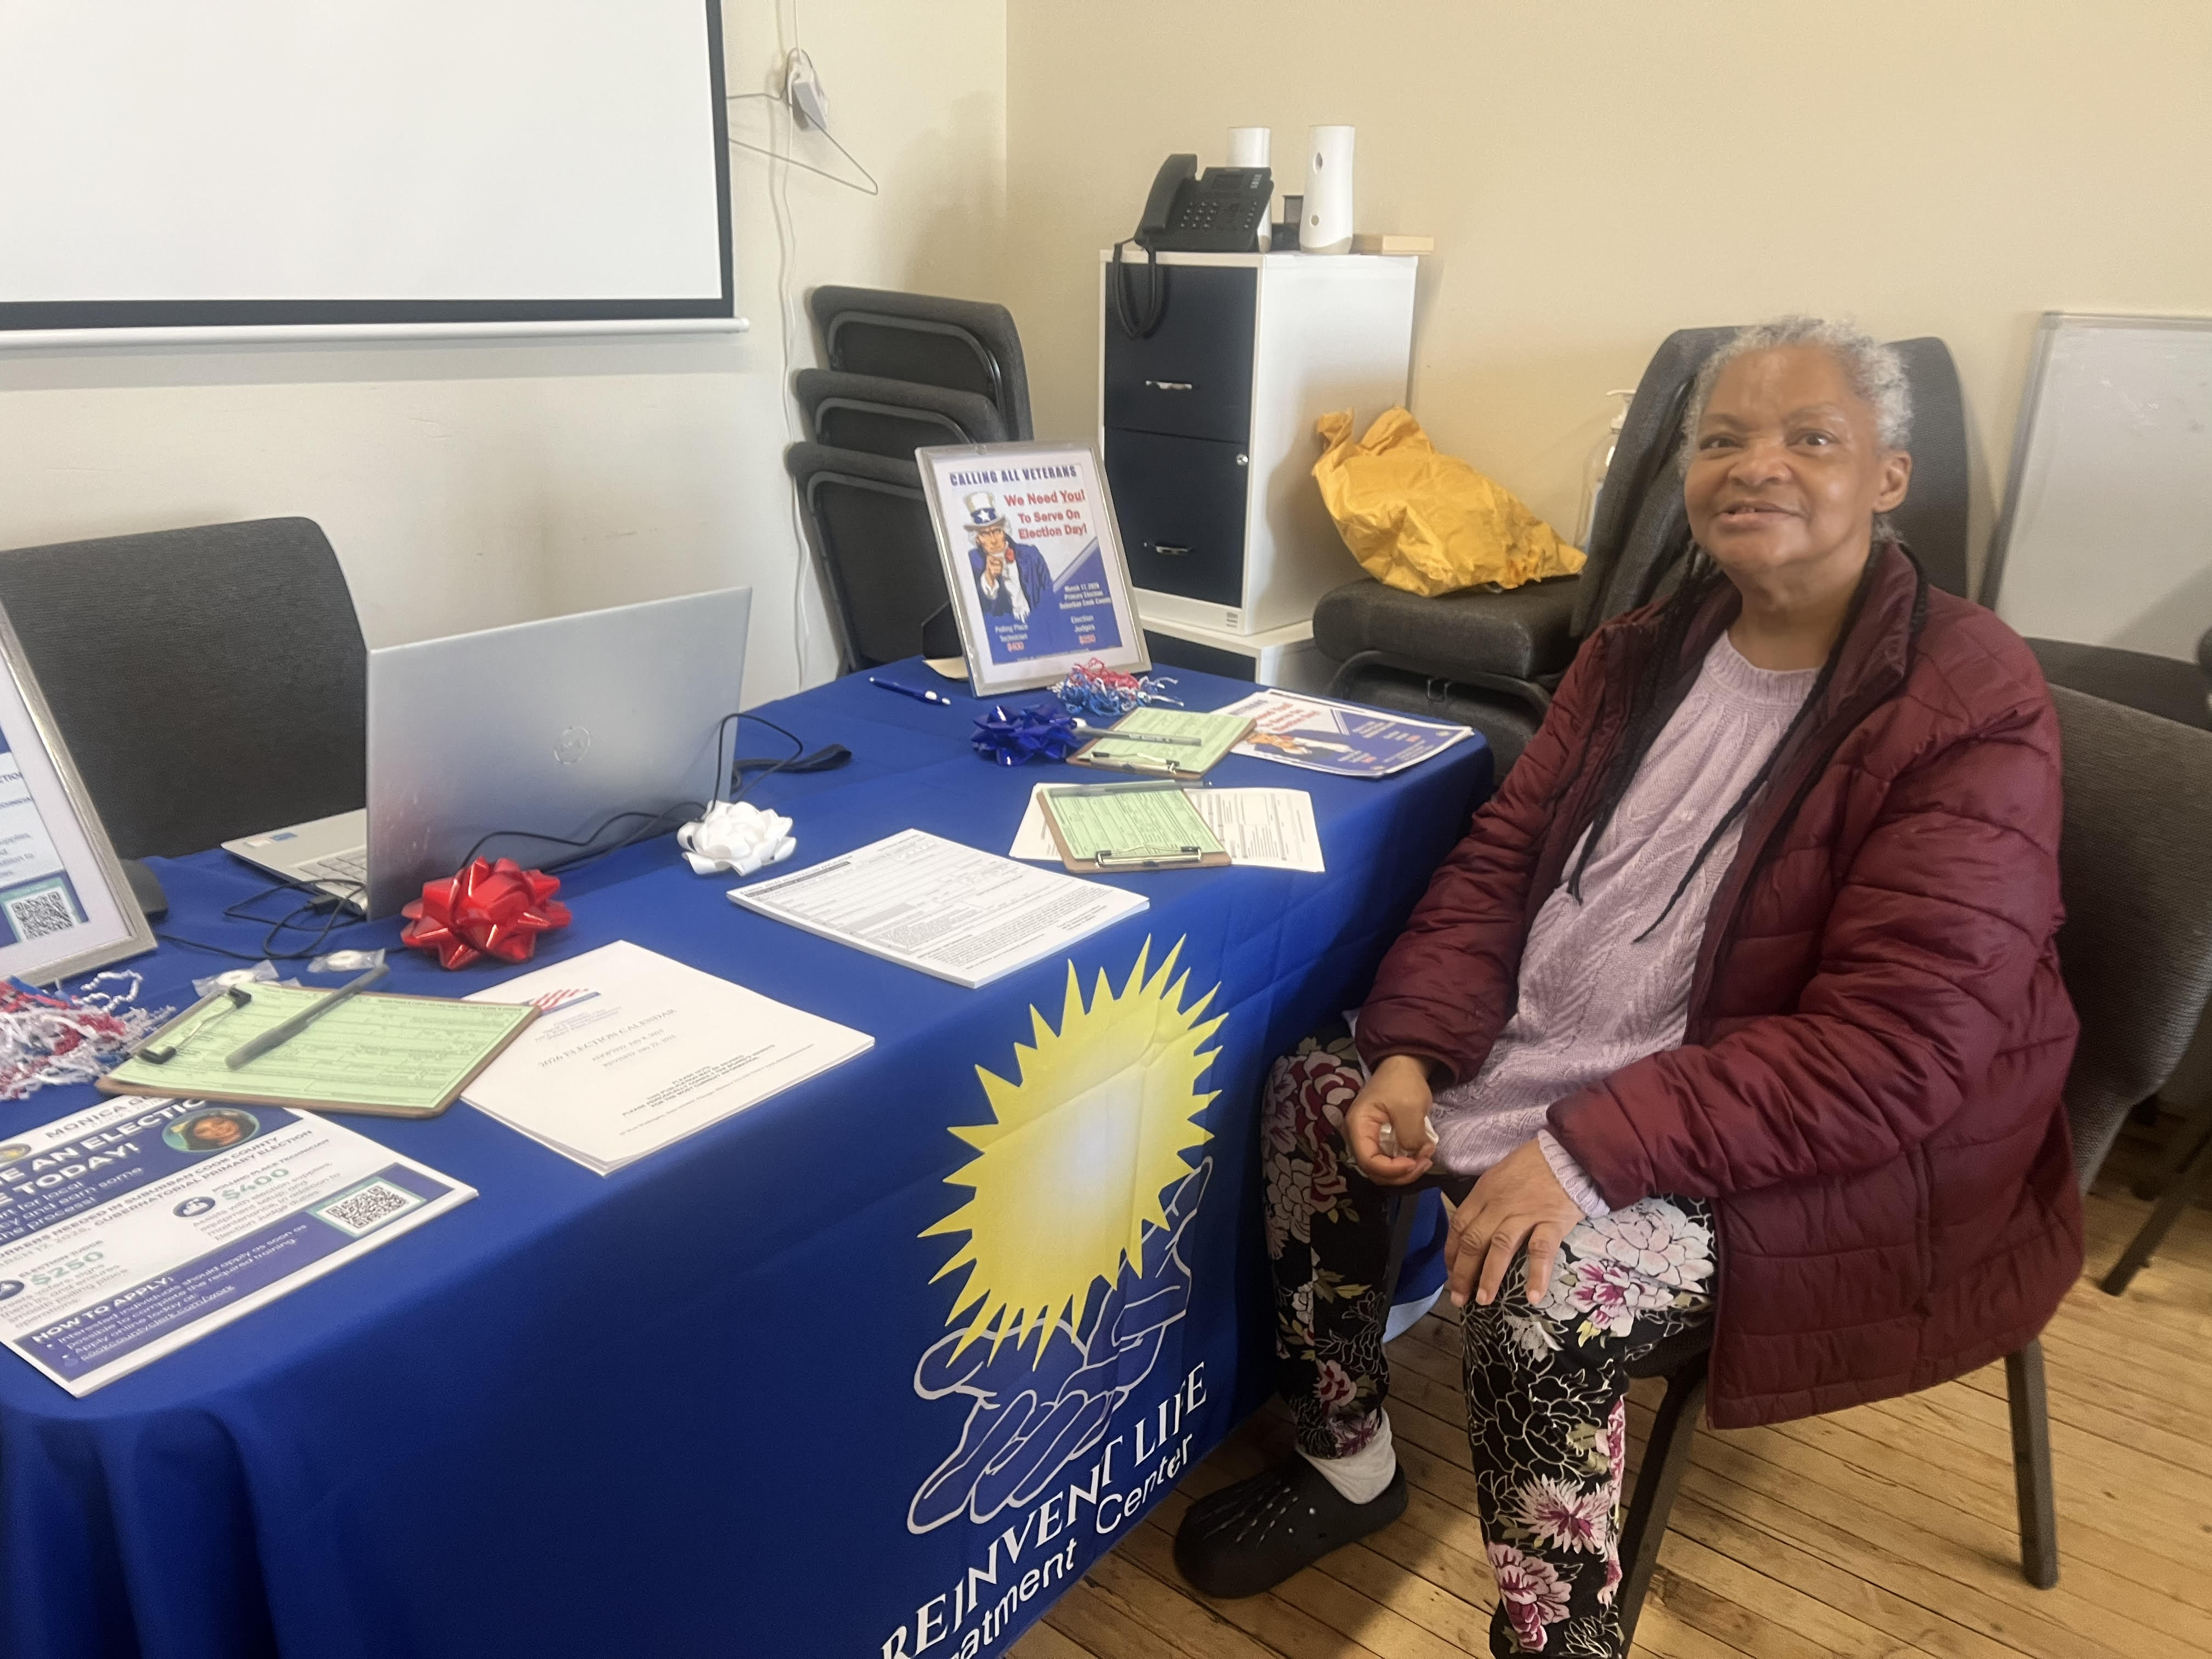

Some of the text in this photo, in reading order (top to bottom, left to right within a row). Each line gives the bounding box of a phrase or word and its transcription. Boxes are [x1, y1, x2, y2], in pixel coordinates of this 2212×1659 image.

[949, 464, 1077, 486] CALLING ALL VETERANS
[1003, 488, 1086, 506] We Need You!
[1017, 507, 1081, 524] To Serve On
[1017, 522, 1088, 539] Election Day!
[32, 1146, 81, 1171] AN
[80, 1099, 206, 1150] ELECTIO
[45, 1105, 127, 1138] MONICA
[13, 1142, 140, 1195] TODAY!
[92, 1177, 204, 1224] GUBERNATORIAL
[201, 1154, 256, 1178] PRIMARY
[256, 1130, 313, 1154] ELECTION
[221, 1168, 289, 1200] $400
[0, 1234, 51, 1257] RKERS
[193, 1158, 230, 1173] COOK
[229, 1137, 279, 1158] COUNTY
[16, 1198, 41, 1210] for
[41, 1181, 84, 1200] local
[19, 1202, 55, 1218] and
[57, 1187, 97, 1204] earn
[96, 1167, 144, 1187] some
[266, 1231, 292, 1244] soon
[30, 1251, 104, 1285] $250
[31, 1317, 82, 1342] HOW
[82, 1304, 111, 1319] TO
[74, 1335, 109, 1354] Apply
[881, 1435, 1124, 1658] REINVENT
[951, 1434, 1193, 1658] atment Center
